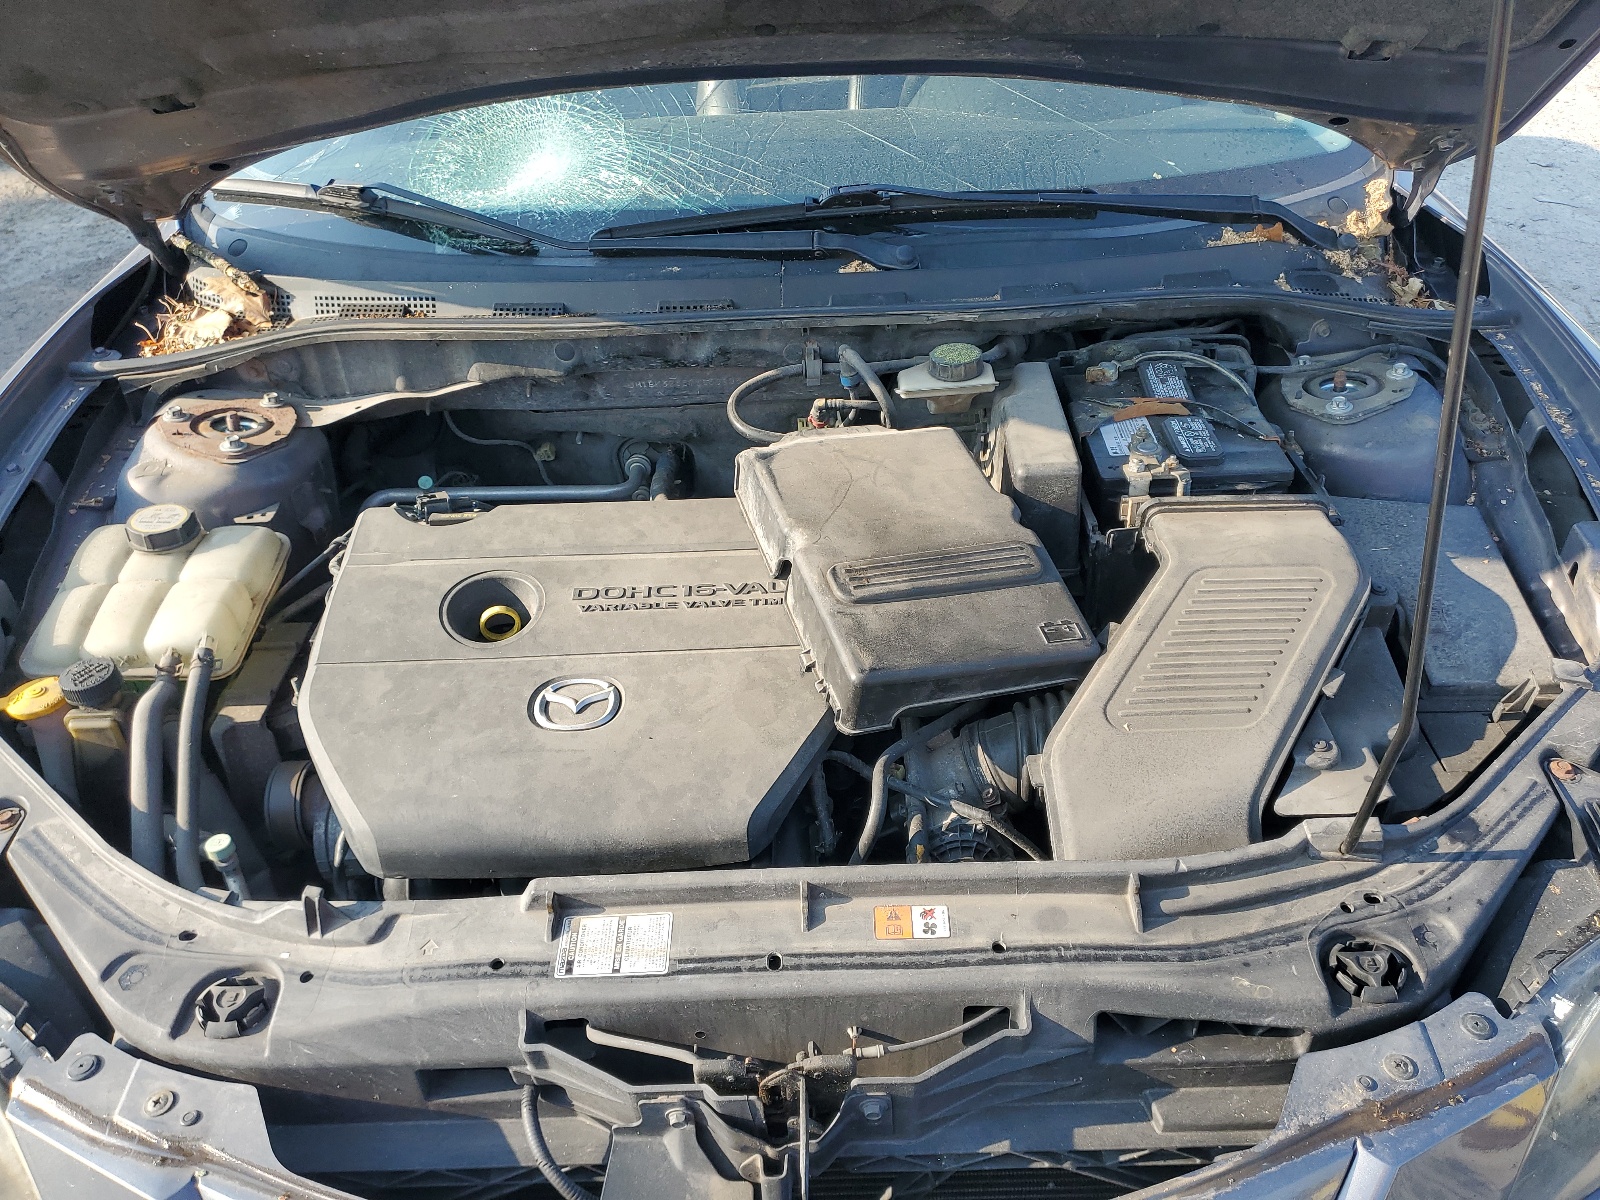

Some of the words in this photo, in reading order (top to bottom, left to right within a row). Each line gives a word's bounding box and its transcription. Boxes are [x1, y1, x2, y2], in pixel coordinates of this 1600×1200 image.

[572, 585, 678, 600] DOHC
[578, 602, 680, 612] VARIABLE
[683, 600, 747, 609] VALVE
[567, 931, 578, 960] CAUTION
